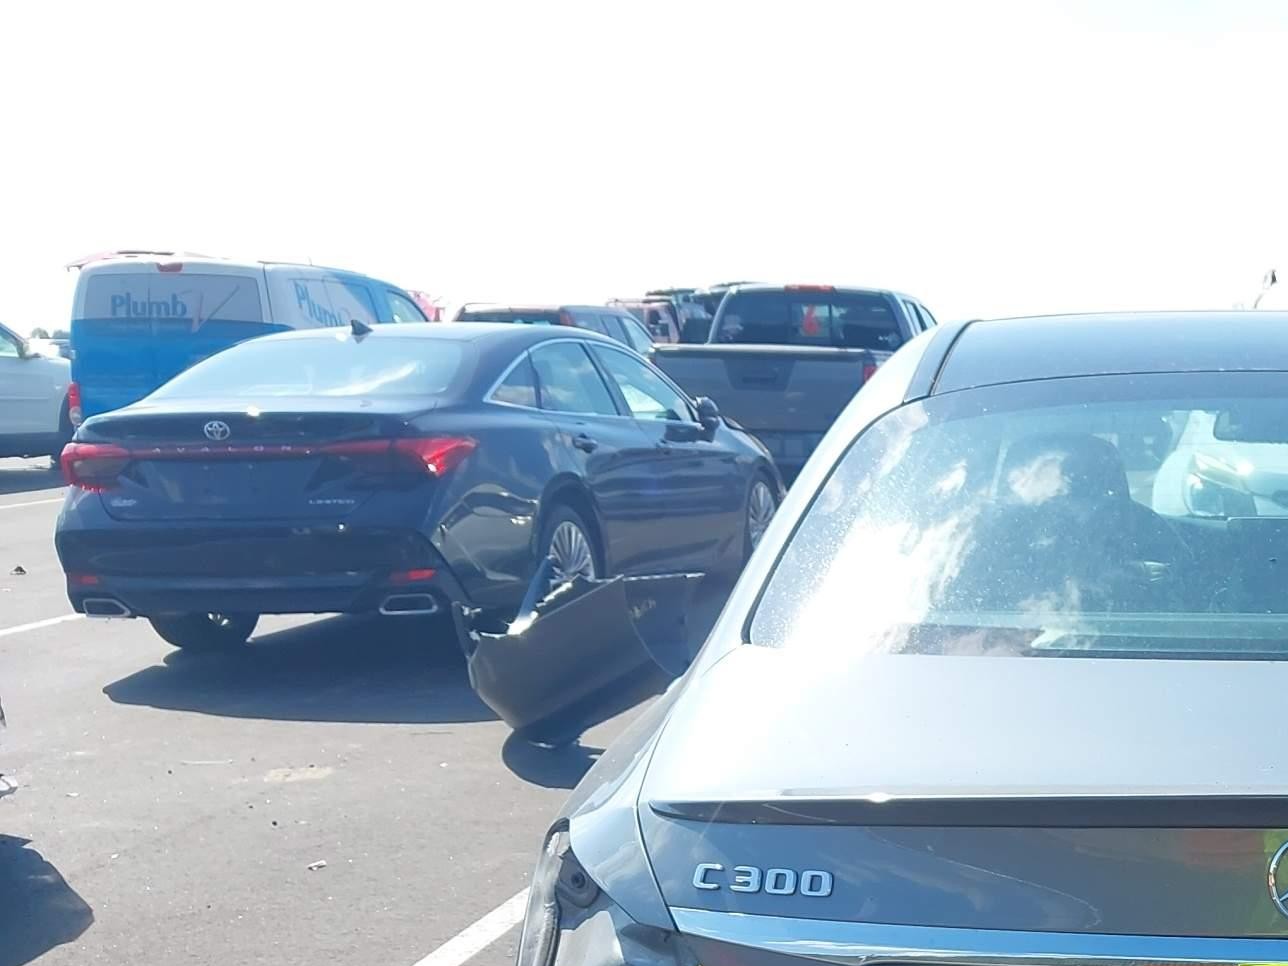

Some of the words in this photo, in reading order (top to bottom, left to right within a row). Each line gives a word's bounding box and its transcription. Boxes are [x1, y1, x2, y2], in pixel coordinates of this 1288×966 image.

[110, 291, 188, 317] Plumb
[153, 445, 293, 454] AVALON
[692, 863, 723, 889] C
[729, 865, 834, 897] 300
